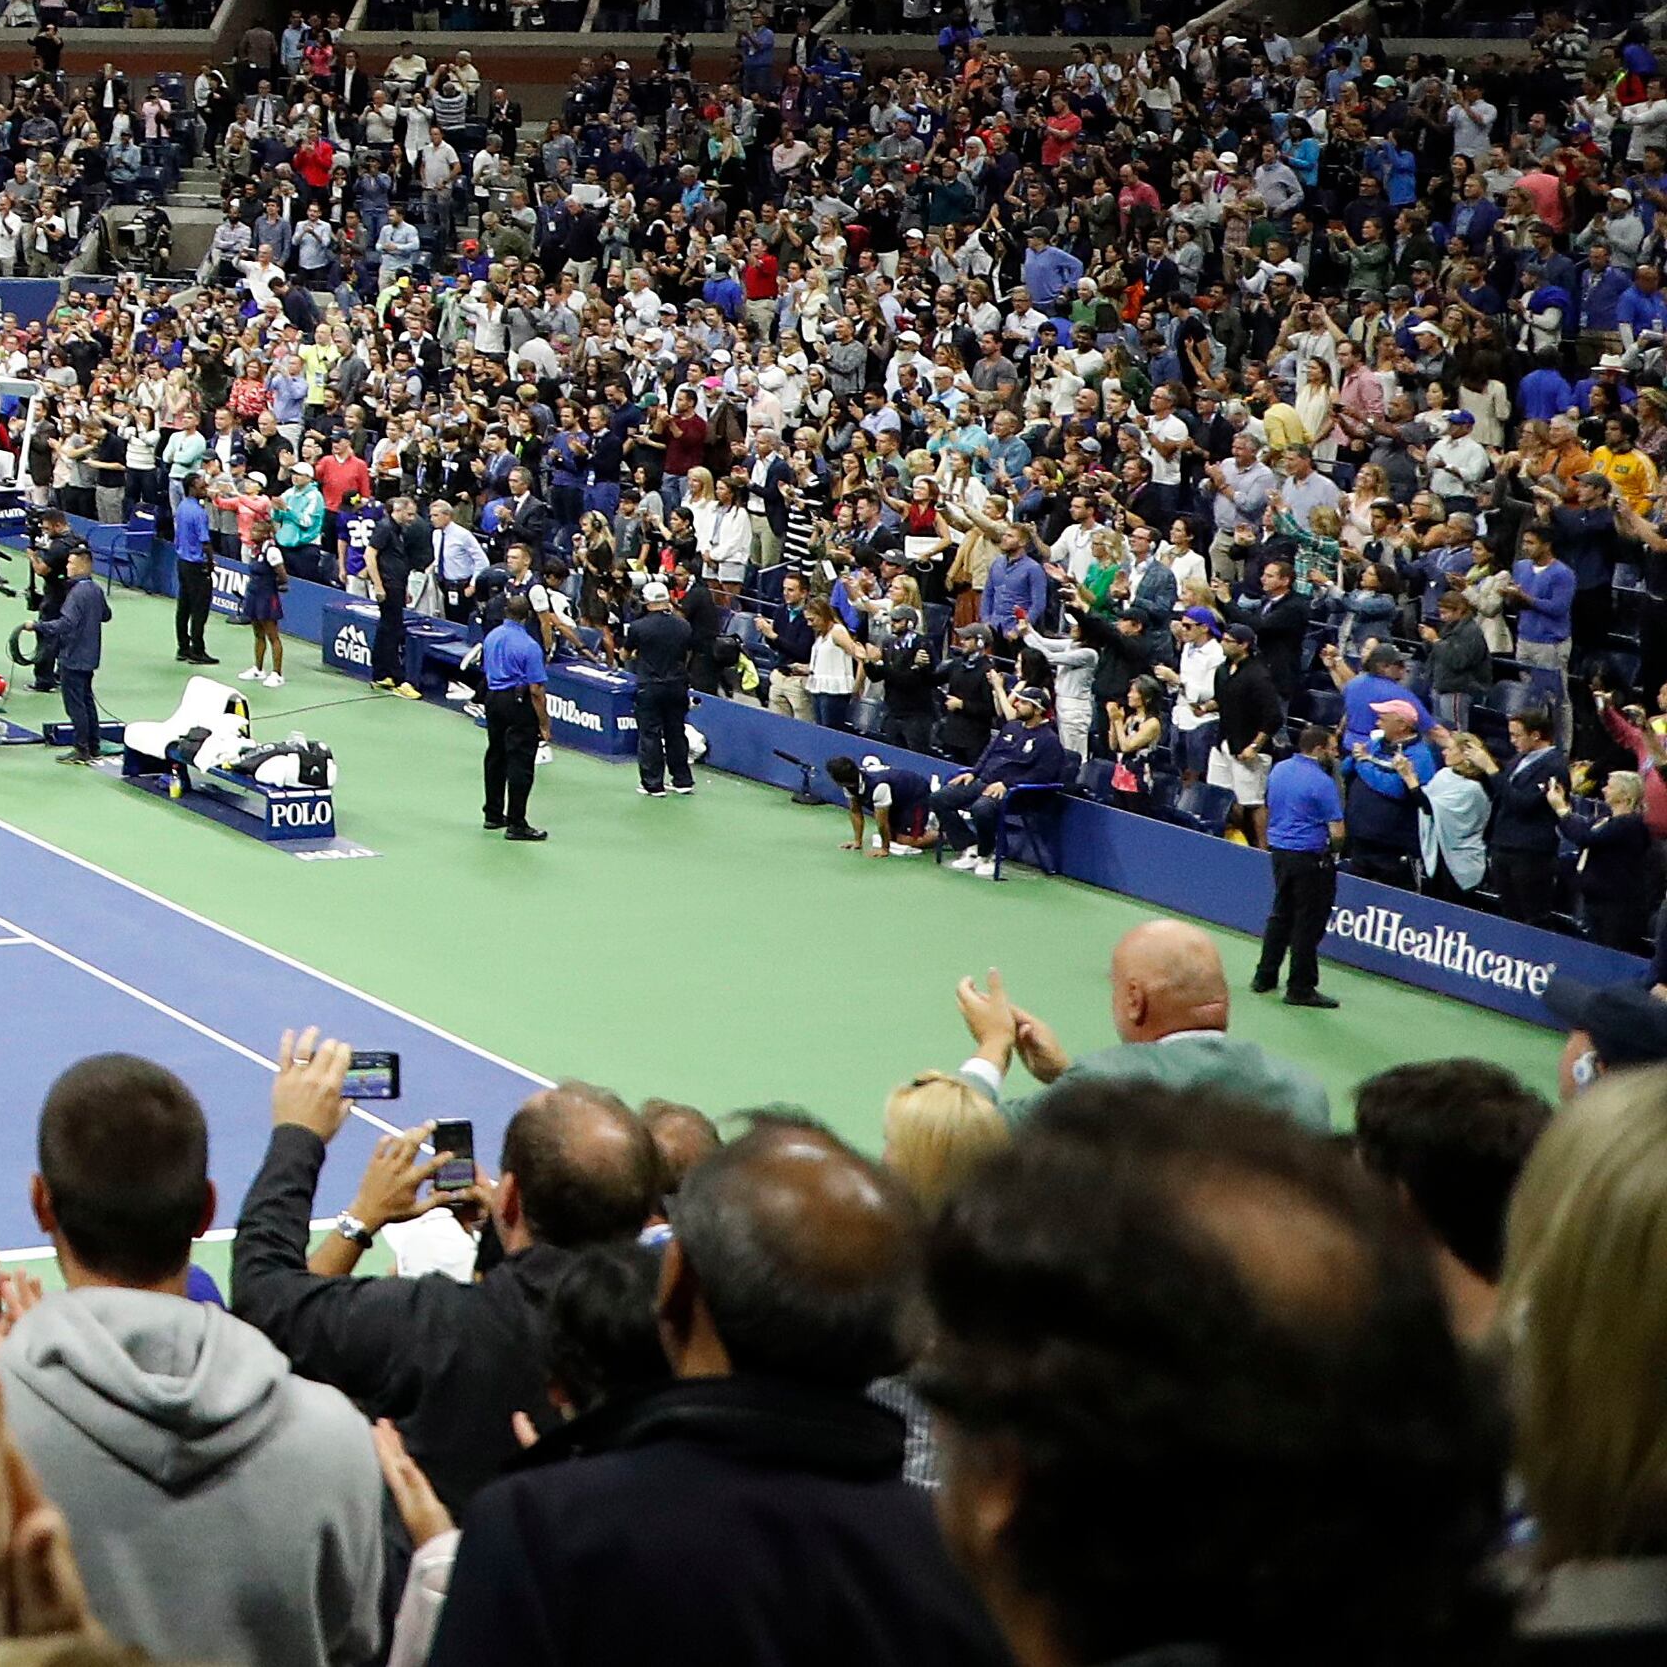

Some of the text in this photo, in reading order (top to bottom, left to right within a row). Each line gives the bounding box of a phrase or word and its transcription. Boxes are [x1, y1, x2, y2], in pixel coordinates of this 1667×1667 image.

[211, 566, 251, 596] STIN
[334, 638, 373, 667] evian
[546, 694, 604, 732] Wilson
[271, 801, 332, 827] POLO
[1325, 906, 1550, 996] tedHealthcare
